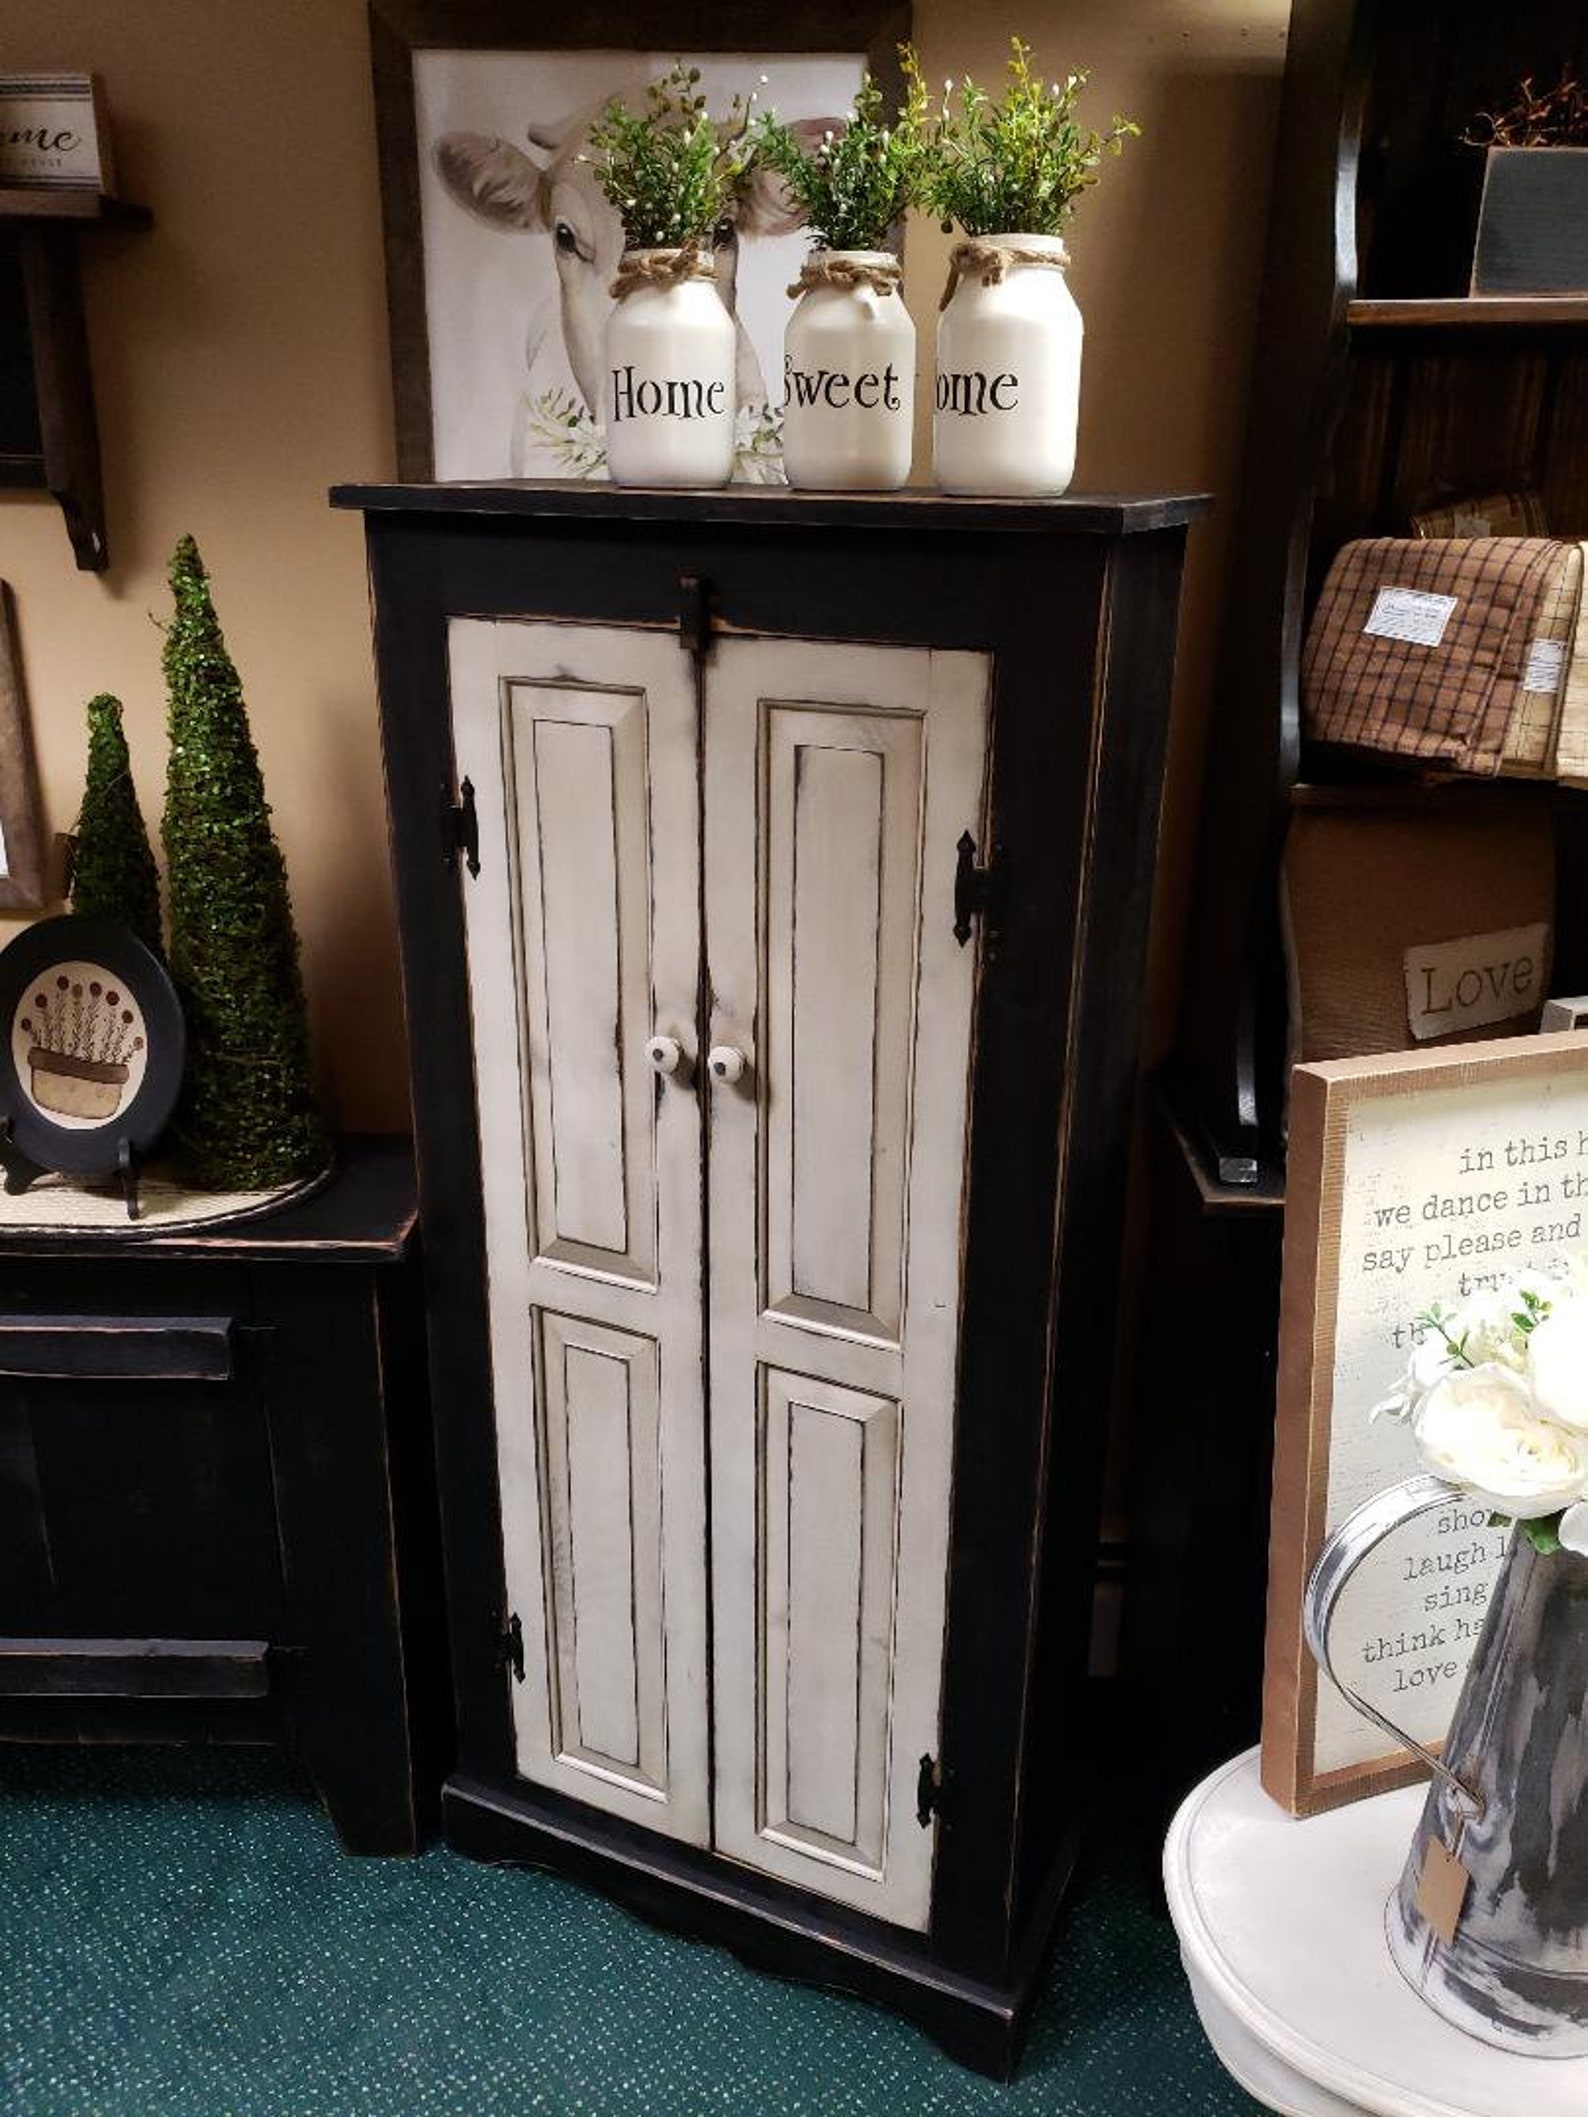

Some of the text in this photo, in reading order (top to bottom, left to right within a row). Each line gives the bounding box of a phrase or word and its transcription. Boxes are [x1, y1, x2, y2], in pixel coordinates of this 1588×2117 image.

[612, 366, 725, 422] Home
[937, 371, 1018, 416] ome
[1420, 956, 1534, 1015] Love
[1459, 1148, 1494, 1174] in
[1504, 1136, 1568, 1167] this
[1374, 1205, 1411, 1228] we
[1422, 1190, 1508, 1220] dance
[1517, 1182, 1550, 1206] in
[1362, 1213, 1581, 1273] say please and
[1438, 1508, 1491, 1535] sho
[1403, 1542, 1487, 1581] laugh
[1424, 1582, 1488, 1612] sing
[1362, 1625, 1446, 1663] think
[1392, 1661, 1457, 1693] love
